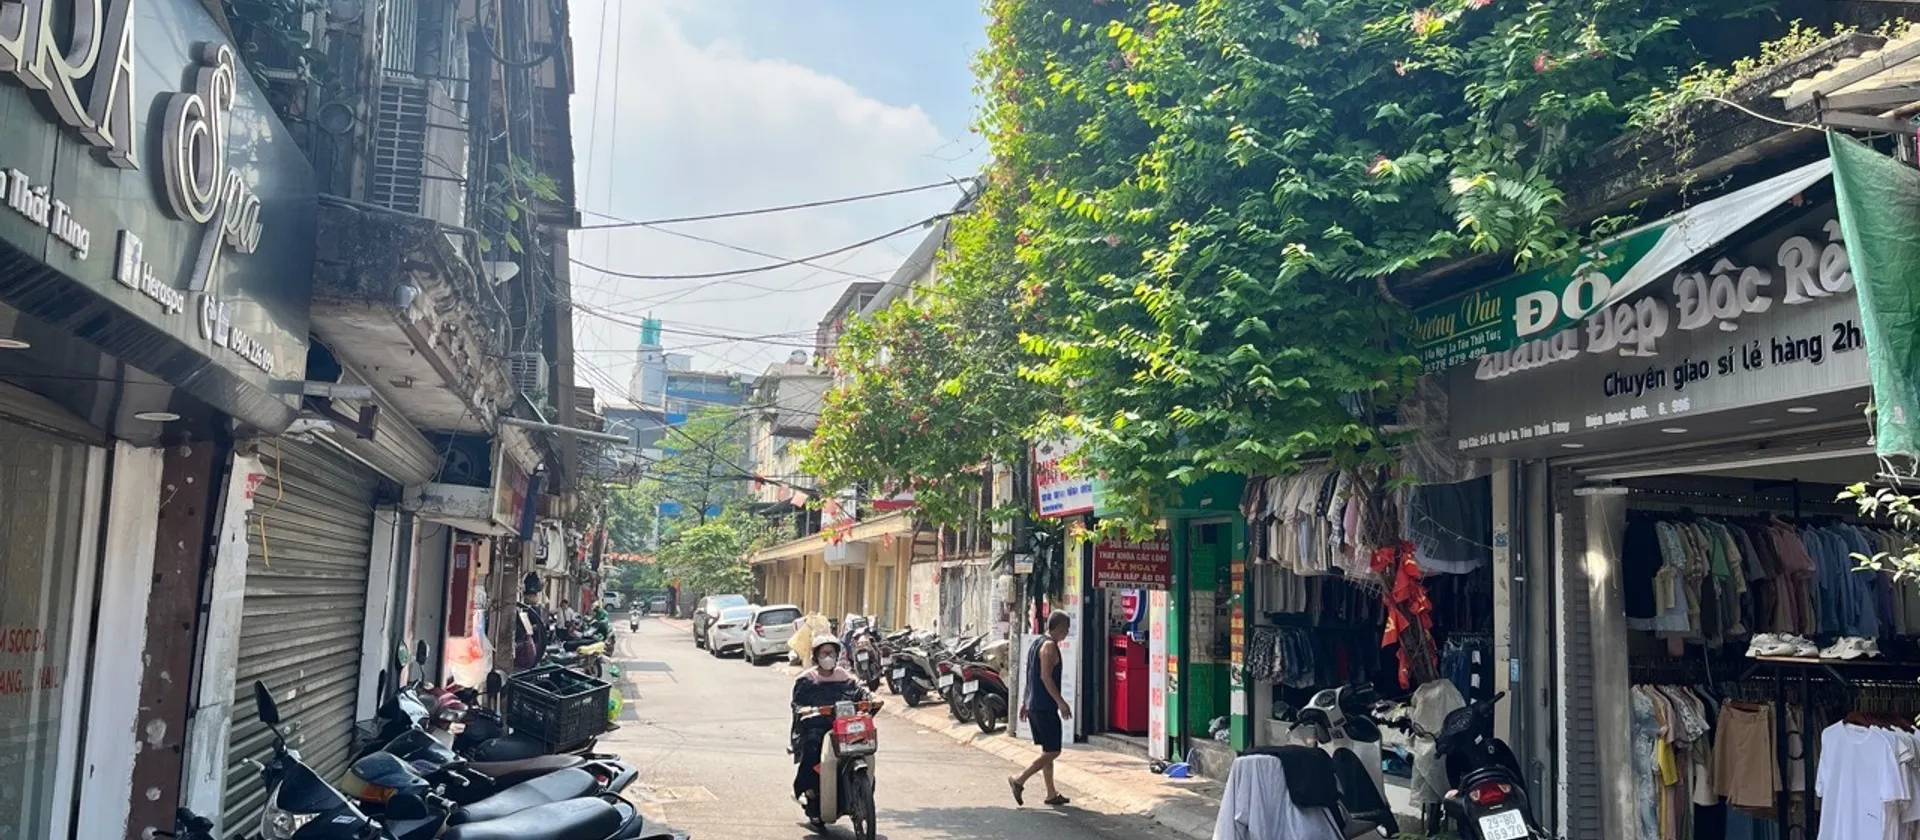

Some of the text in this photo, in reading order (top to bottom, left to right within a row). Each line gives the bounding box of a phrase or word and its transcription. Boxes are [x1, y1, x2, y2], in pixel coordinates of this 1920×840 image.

[8, 168, 51, 228] Thất
[51, 199, 91, 261] Tùng
[141, 261, 185, 315] Herospa
[1672, 256, 1773, 332] Độc
[1777, 218, 1855, 305] Rẻ
[1603, 364, 1668, 399] Chuyên
[1673, 356, 1712, 391] giao
[1742, 339, 1763, 372] lẻ
[1771, 332, 1825, 365] hàng
[1129, 563, 1159, 572] NGAY
[8, 621, 32, 653] SÓC
